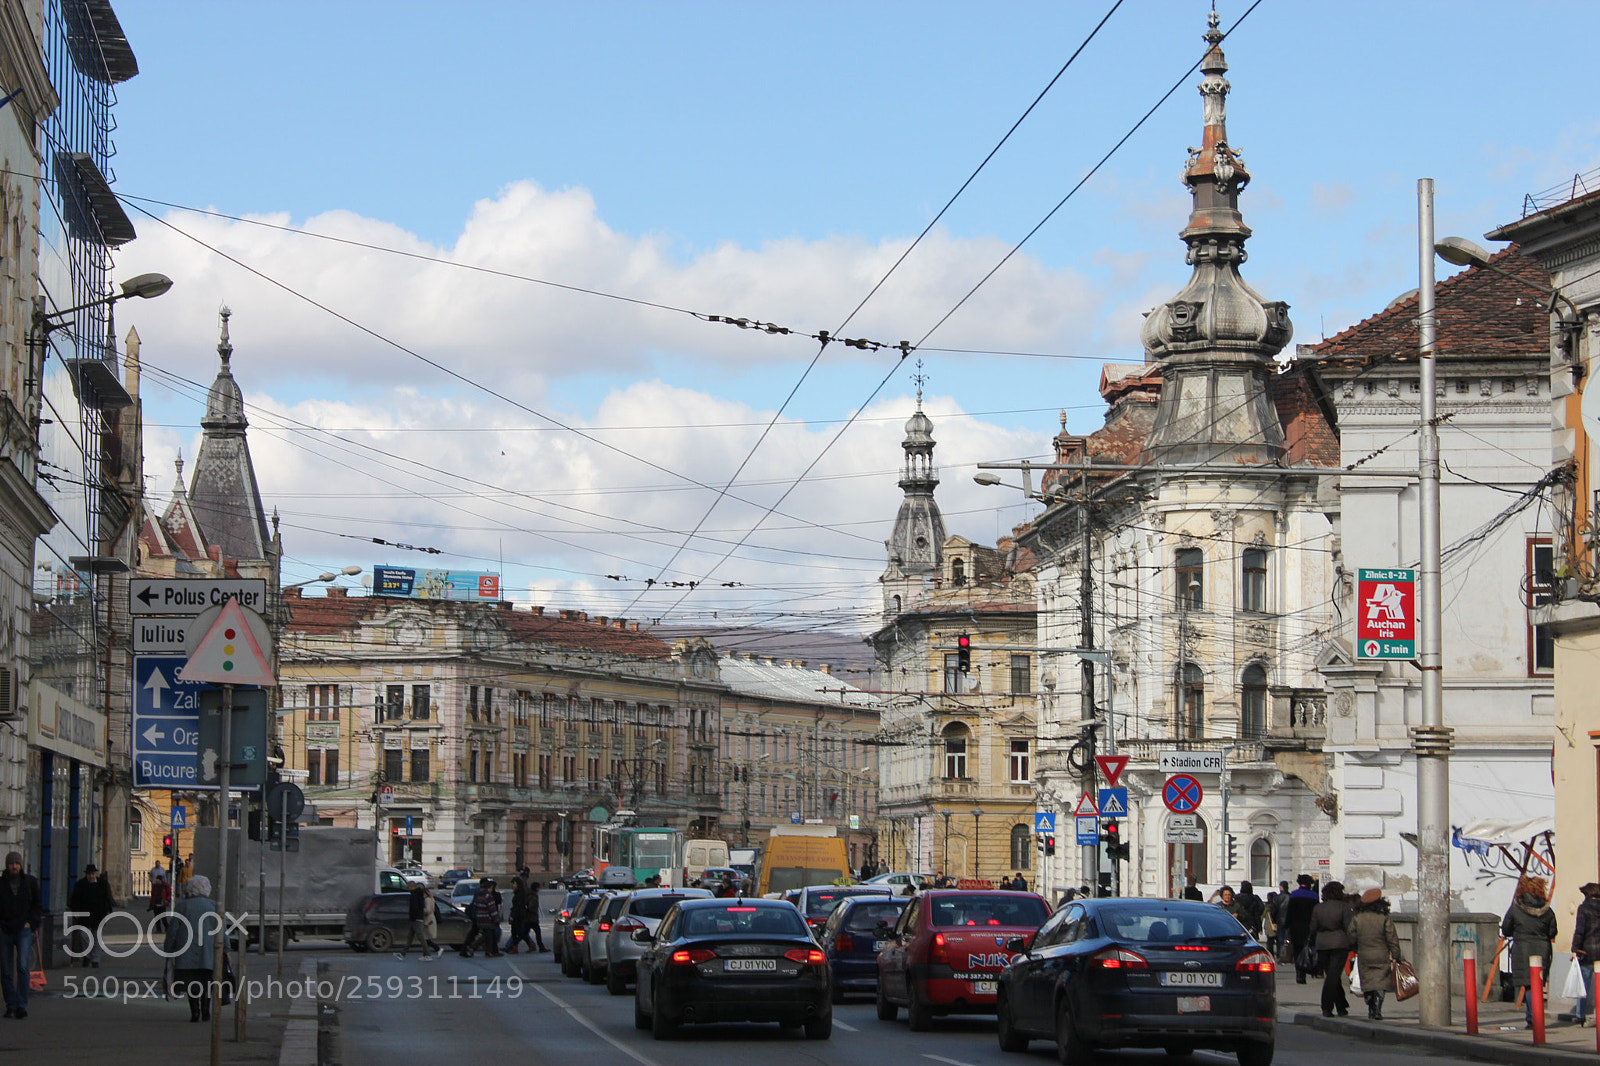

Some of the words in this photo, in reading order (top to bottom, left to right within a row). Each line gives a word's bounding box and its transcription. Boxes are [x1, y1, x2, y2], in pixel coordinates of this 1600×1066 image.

[164, 587, 206, 606] Polus
[210, 587, 260, 606] Center
[1367, 620, 1406, 629] Auchan
[141, 625, 185, 643] Iulius
[1379, 629, 1395, 638] Iris
[1384, 644, 1390, 654] 5
[1391, 644, 1409, 654] min
[173, 691, 200, 709] Zal
[1171, 756, 1201, 768] Stadion
[1203, 756, 1220, 769] CFR
[730, 960, 742, 969] CJ
[744, 960, 754, 970] 01
[755, 961, 775, 970] YNO
[1169, 973, 1183, 983] CJ
[1186, 974, 1197, 984] 01
